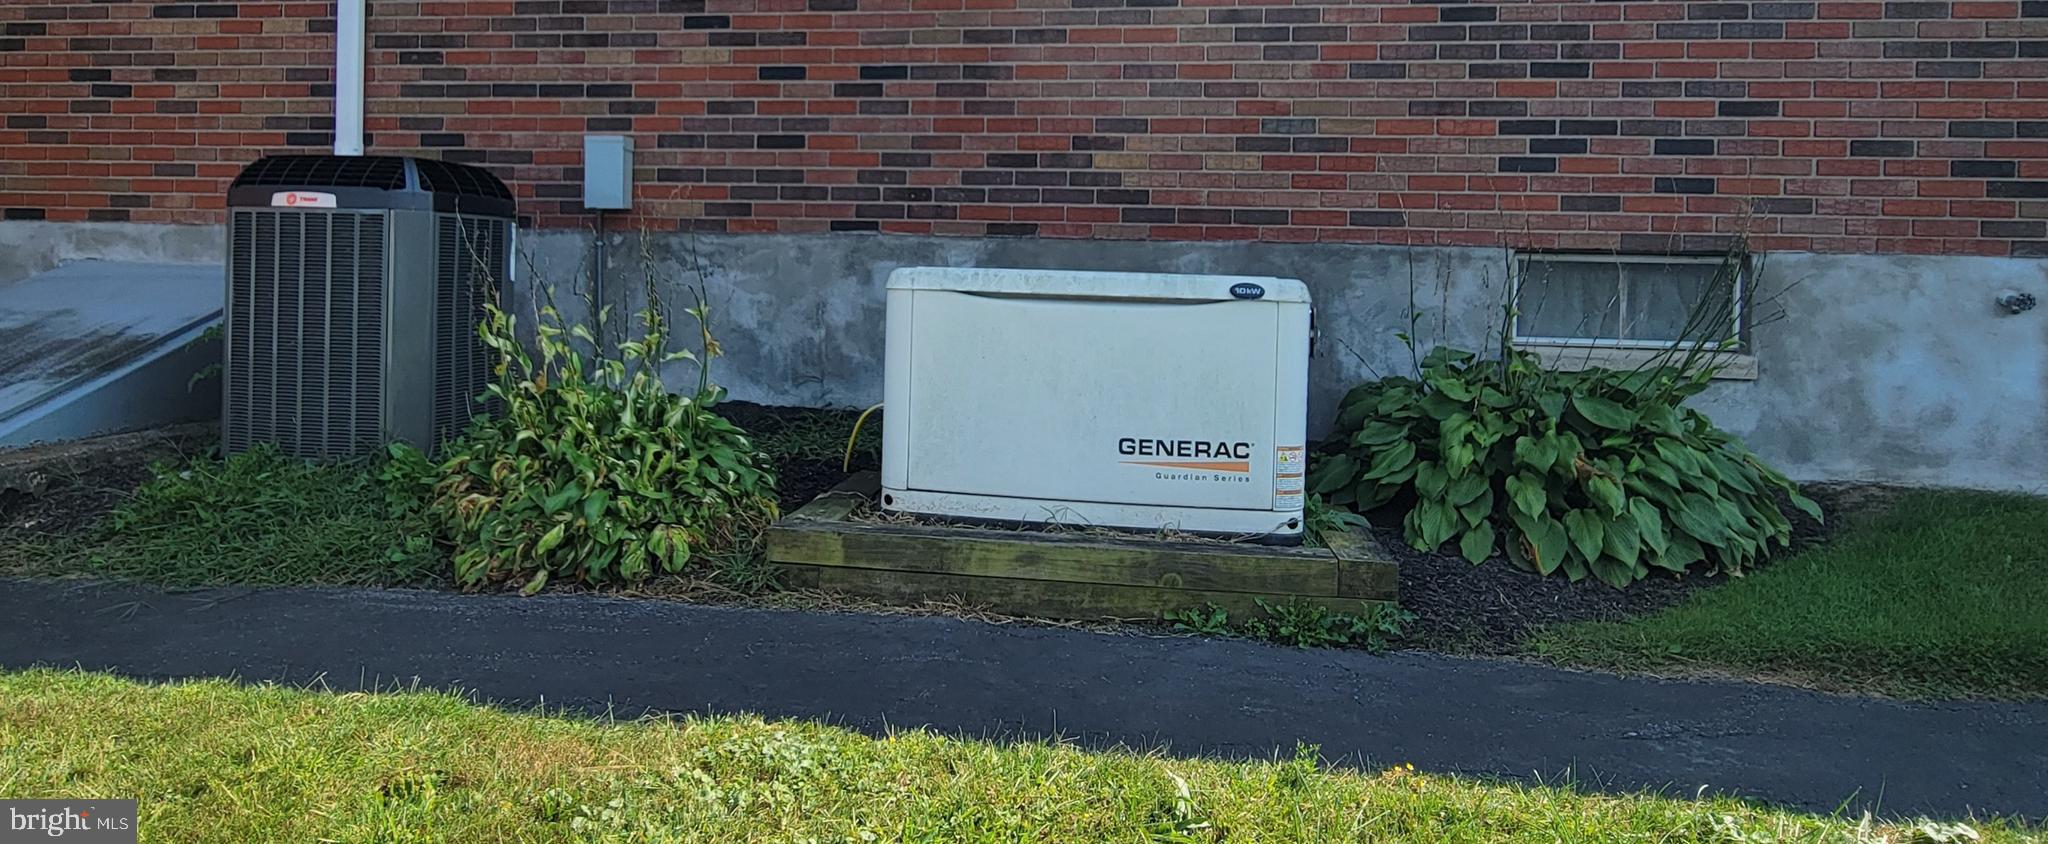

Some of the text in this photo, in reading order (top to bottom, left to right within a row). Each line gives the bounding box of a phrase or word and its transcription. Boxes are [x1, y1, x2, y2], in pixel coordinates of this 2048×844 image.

[1118, 437, 1250, 459] GENERAC
[1155, 472, 1250, 483] Guardian Series
